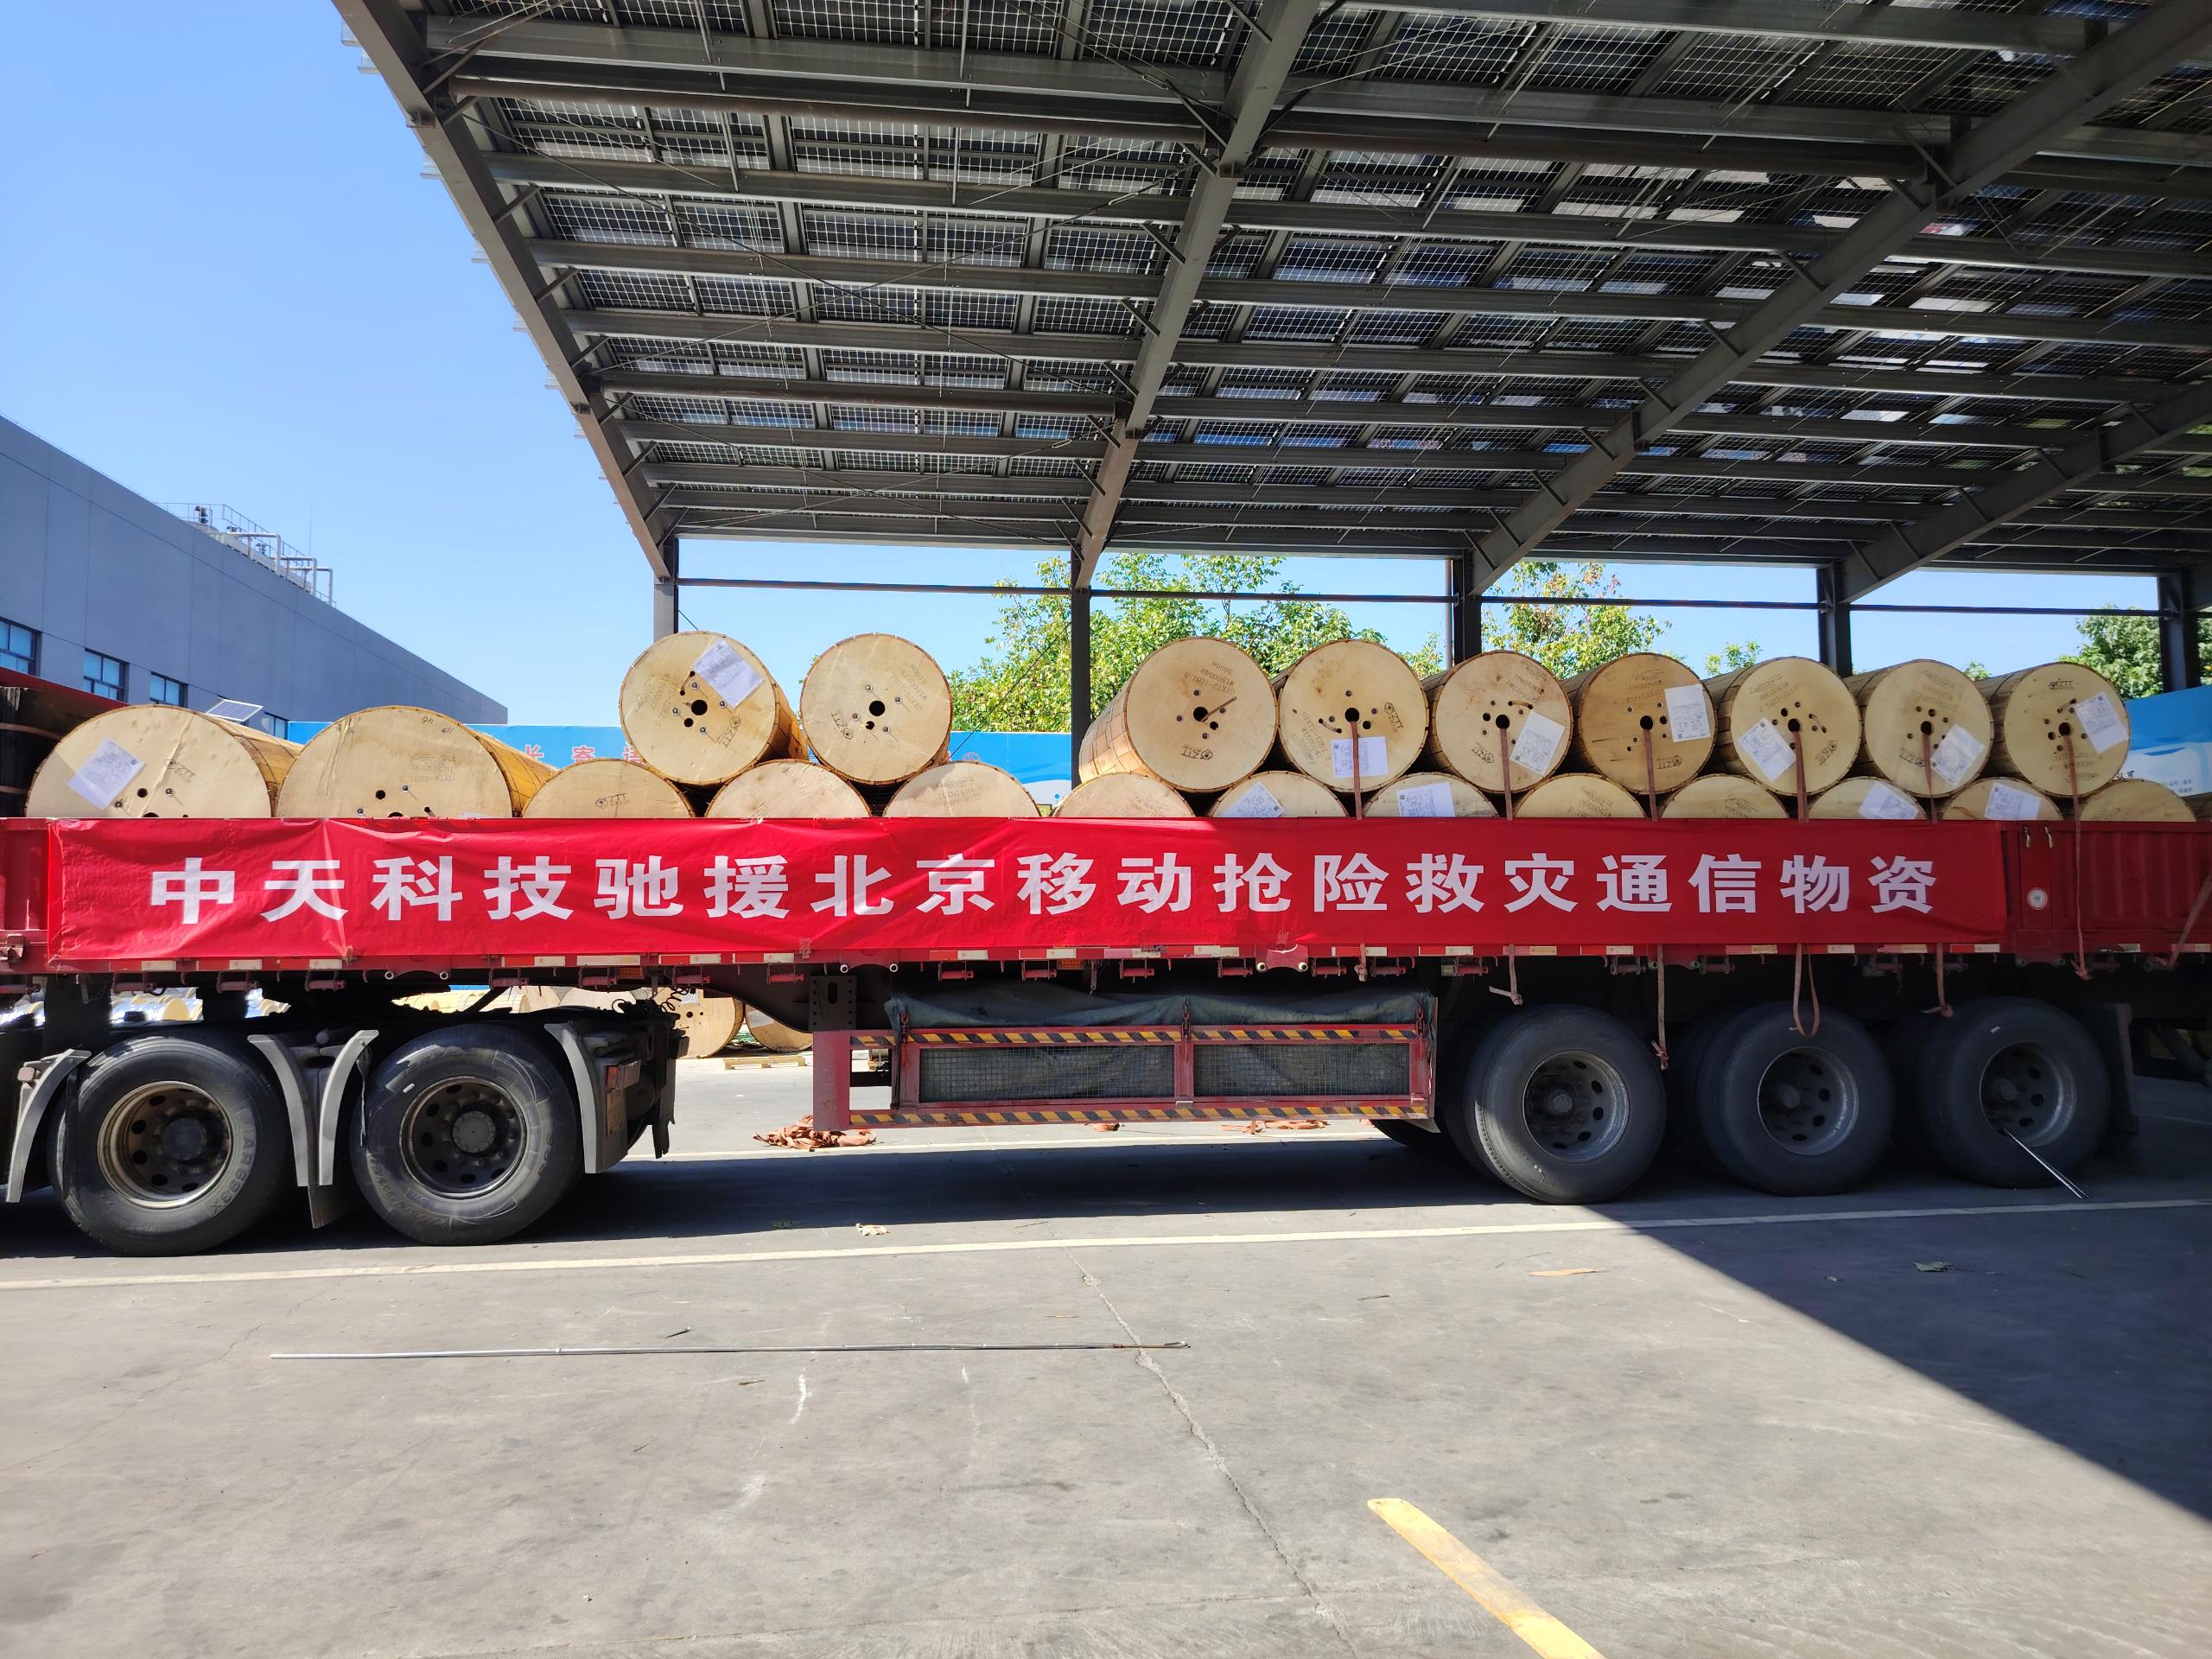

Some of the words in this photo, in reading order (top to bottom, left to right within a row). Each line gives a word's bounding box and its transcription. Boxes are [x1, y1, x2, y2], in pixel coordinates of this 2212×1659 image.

[149, 851, 1937, 926] 中天科技驰援北京移动抢险救灾通信物资
